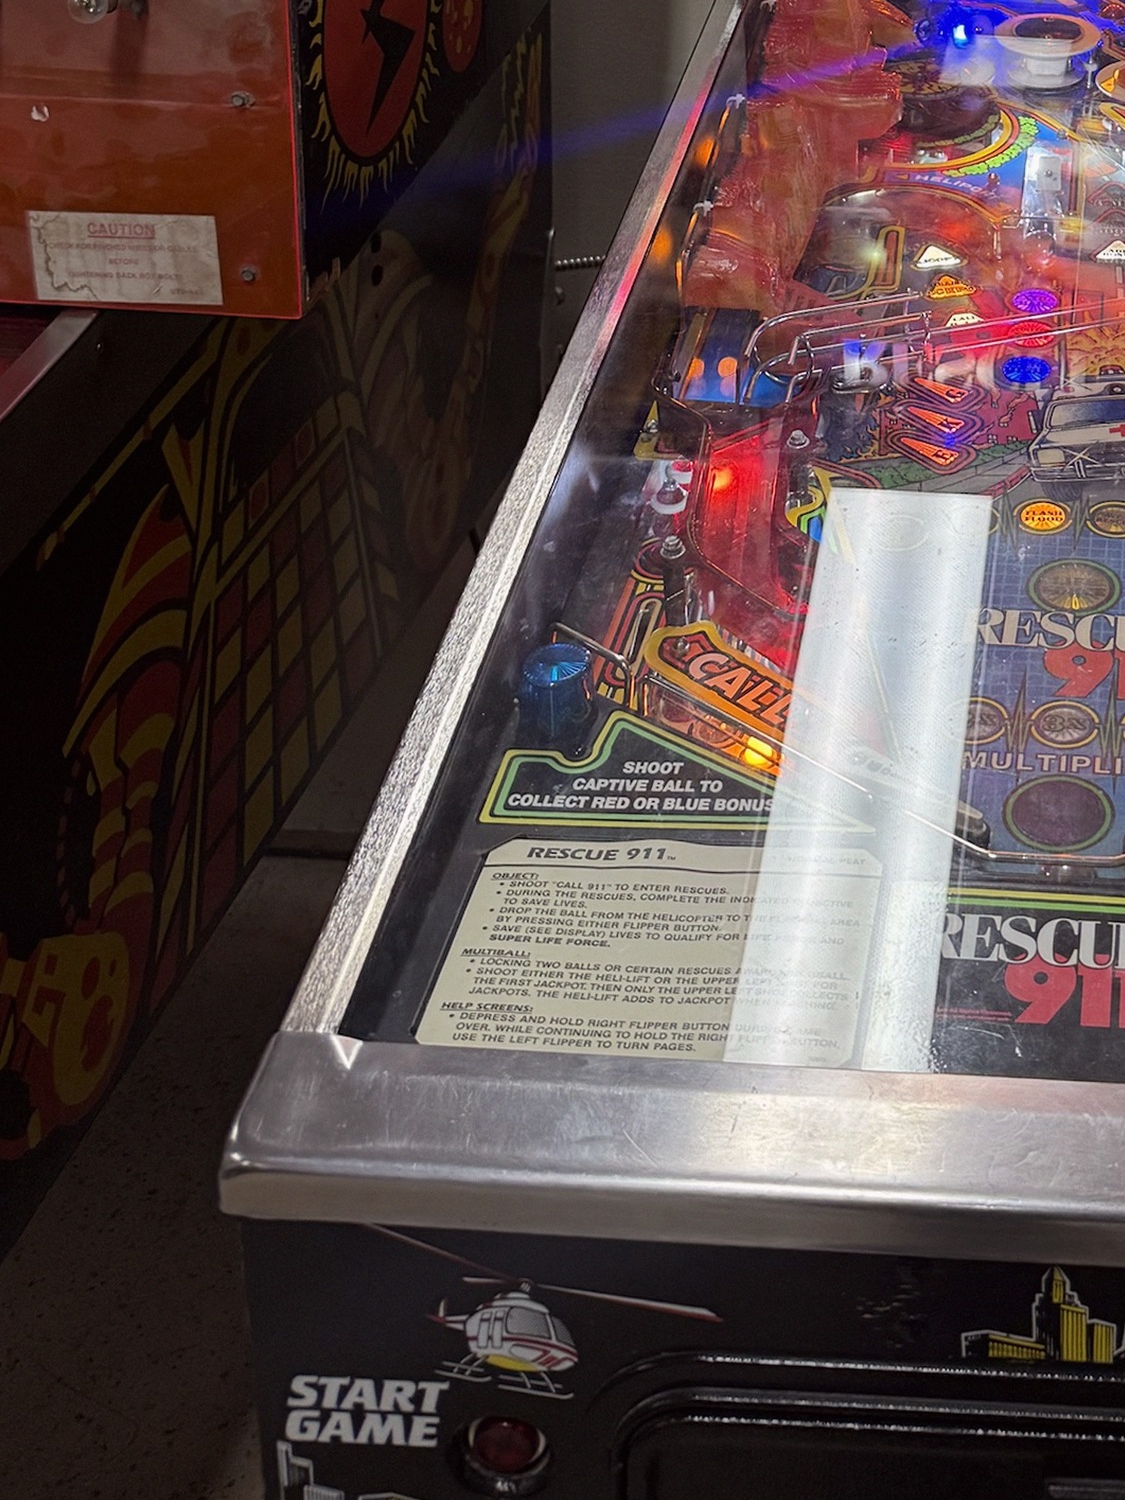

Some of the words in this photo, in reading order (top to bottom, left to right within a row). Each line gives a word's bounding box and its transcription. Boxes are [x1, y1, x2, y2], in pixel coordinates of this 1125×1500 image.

[87, 222, 155, 236] CAUTION
[1024, 509, 1063, 517] FLASH
[1024, 515, 1063, 523] FLOOD
[622, 761, 684, 775] SHOOT
[573, 778, 649, 793] CAPTIVE
[651, 780, 695, 793] BALL
[700, 781, 723, 793] TO
[508, 793, 589, 809] COLLECT
[591, 797, 630, 810] RED
[633, 797, 659, 810] OR
[663, 798, 711, 811] BLUE
[714, 798, 775, 812] BONUS
[527, 847, 619, 861] RESCUE
[627, 847, 666, 861] 911
[506, 889, 550, 898] DURING
[555, 890, 578, 898] THE
[637, 893, 700, 904] COMPLETE
[705, 896, 726, 904] THE
[633, 884, 670, 892] ENTER
[674, 885, 729, 895] RESCUES.
[521, 898, 551, 907] SAVE
[553, 900, 588, 909] LIVES.
[499, 906, 532, 915] DROP
[535, 908, 557, 916] THE
[559, 909, 587, 918] BALL
[590, 911, 624, 920] FROM
[627, 912, 650, 921] THE
[652, 913, 723, 923] HELICOPTER
[727, 914, 741, 922] TO
[496, 915, 512, 924] BY
[515, 916, 573, 927] PRESSING
[578, 919, 619, 929] EITHER
[623, 921, 669, 930] FLIPPER
[674, 923, 721, 932] BUTTON.
[492, 924, 521, 933] SAVE
[525, 926, 552, 935] (SEE
[556, 927, 605, 938] DISPLAY)
[609, 931, 641, 939] LIVES
[646, 932, 660, 940] TO
[664, 933, 712, 941] QUALIFY
[716, 933, 740, 941] FOR
[489, 934, 531, 943] SUPER
[535, 936, 562, 945] LIFE
[566, 938, 611, 948] FORCE.
[461, 948, 531, 957] MULTIBALL:
[480, 958, 531, 967] LOCKING
[536, 960, 561, 969] TWO
[564, 961, 601, 971] BALLS
[604, 964, 621, 972] OR
[625, 965, 674, 975] CERTAIN
[677, 967, 732, 975] RESCUES
[441, 1002, 473, 1011] HELP
[476, 1003, 534, 1013] SCREENS:
[460, 1012, 516, 1023] DEPRESS
[519, 1015, 546, 1024] AND
[550, 1017, 584, 1027] HOLD
[587, 1019, 626, 1029] RIGHT
[629, 1021, 678, 1030] FLIPPER
[682, 1022, 730, 1032] BUTTON
[452, 1033, 477, 1042] USE
[481, 1034, 506, 1043] THE
[509, 1036, 539, 1045] LEFT
[543, 1038, 592, 1048] FLIPPER
[597, 1040, 612, 1049] TO
[616, 1041, 649, 1051] TURN
[653, 1043, 697, 1053] PAGES.
[287, 1375, 450, 1413] START
[285, 1409, 440, 1448] GAME
